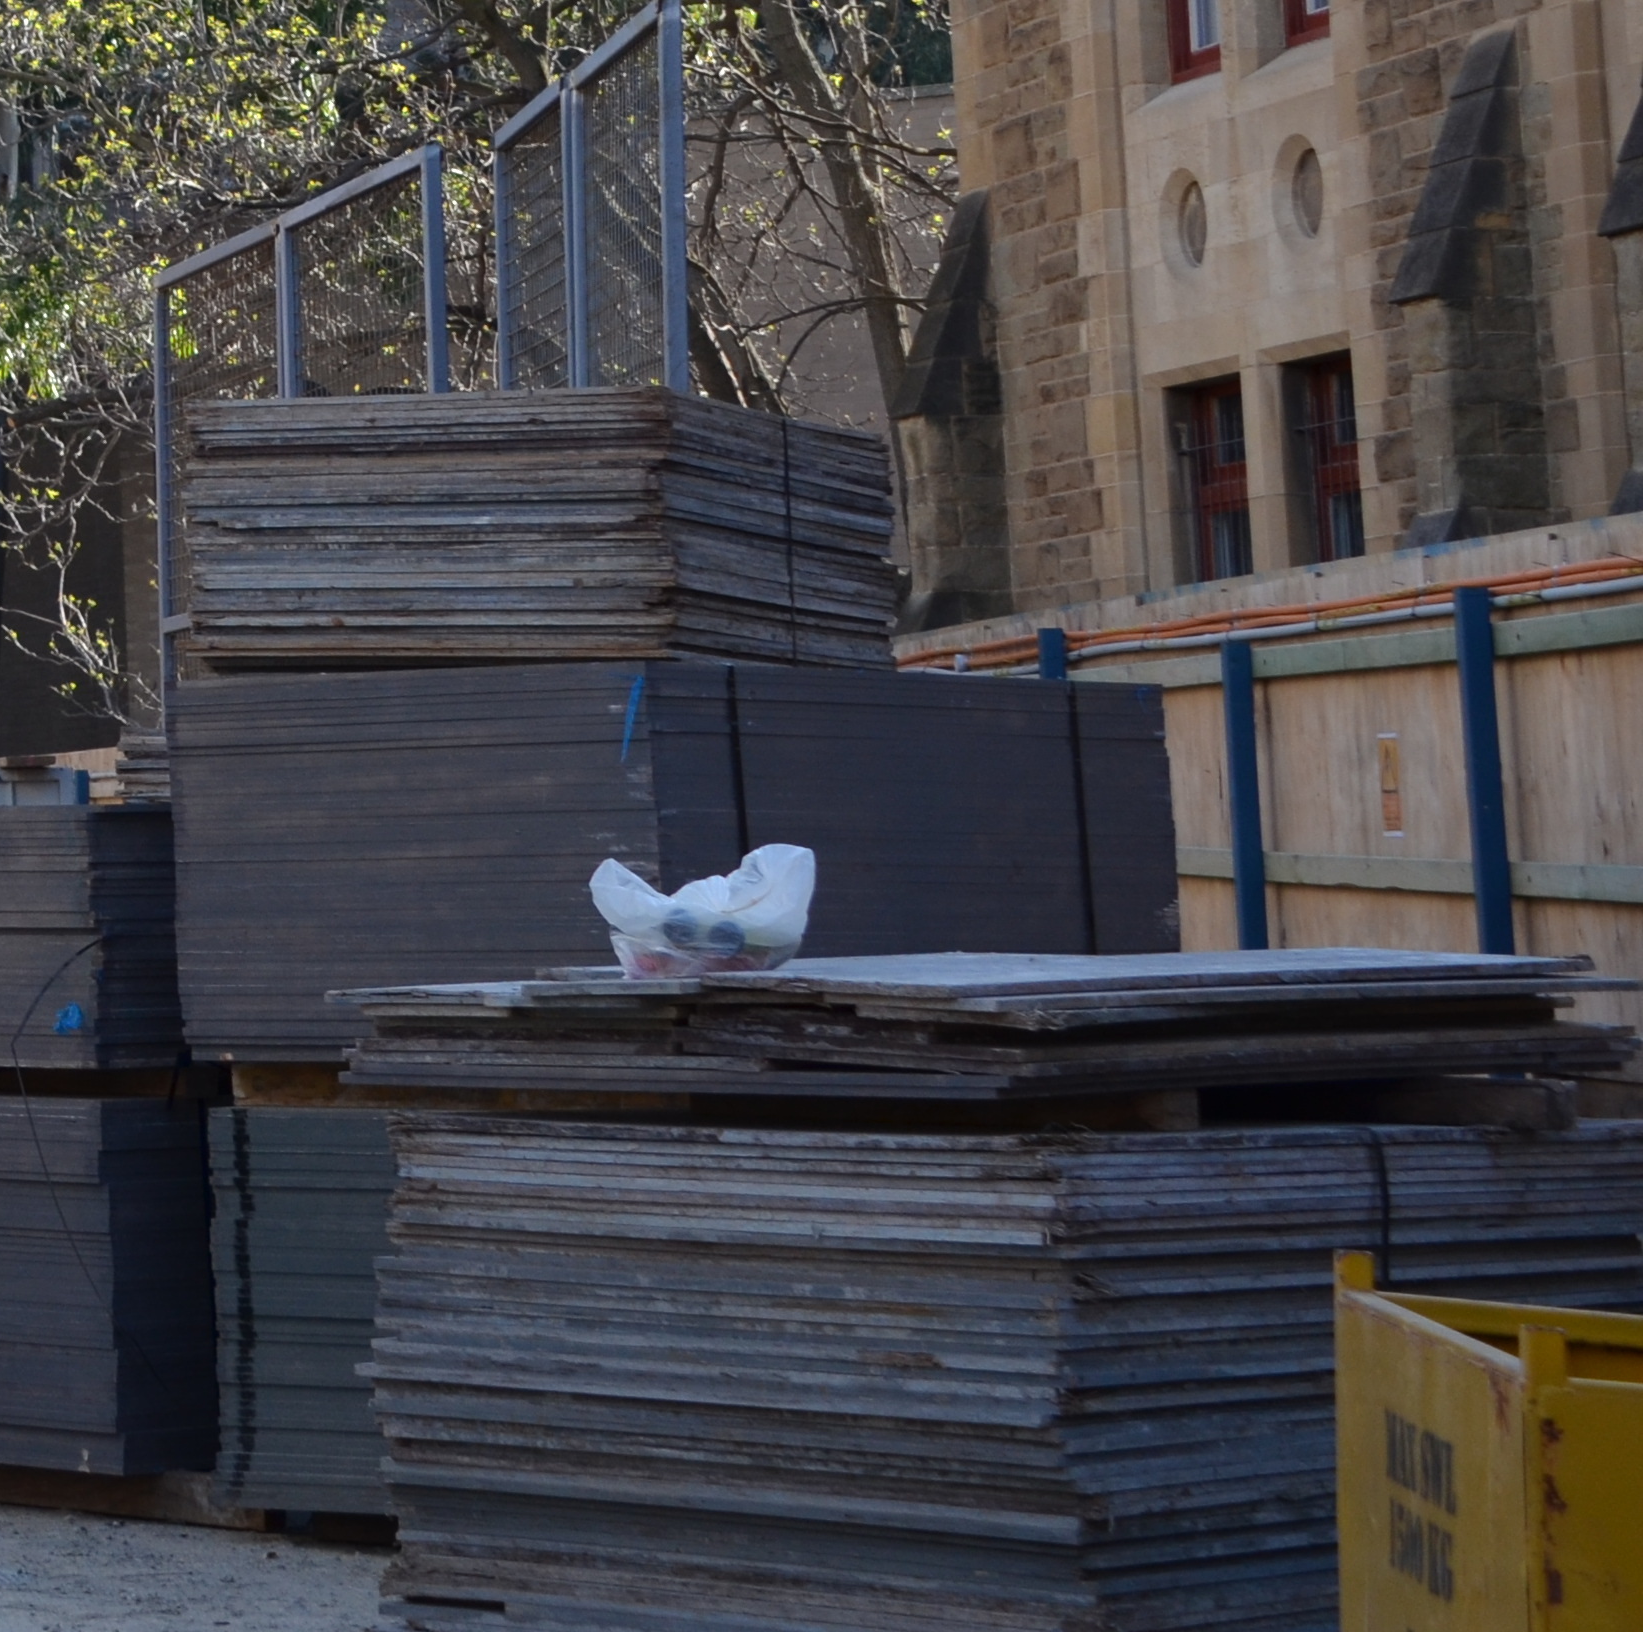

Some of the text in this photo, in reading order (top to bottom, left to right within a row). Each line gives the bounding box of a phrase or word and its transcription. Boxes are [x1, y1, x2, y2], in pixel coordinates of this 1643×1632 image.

[1385, 1406, 1457, 1517] MAX SWL
[1389, 1495, 1455, 1604] 1500 KG
